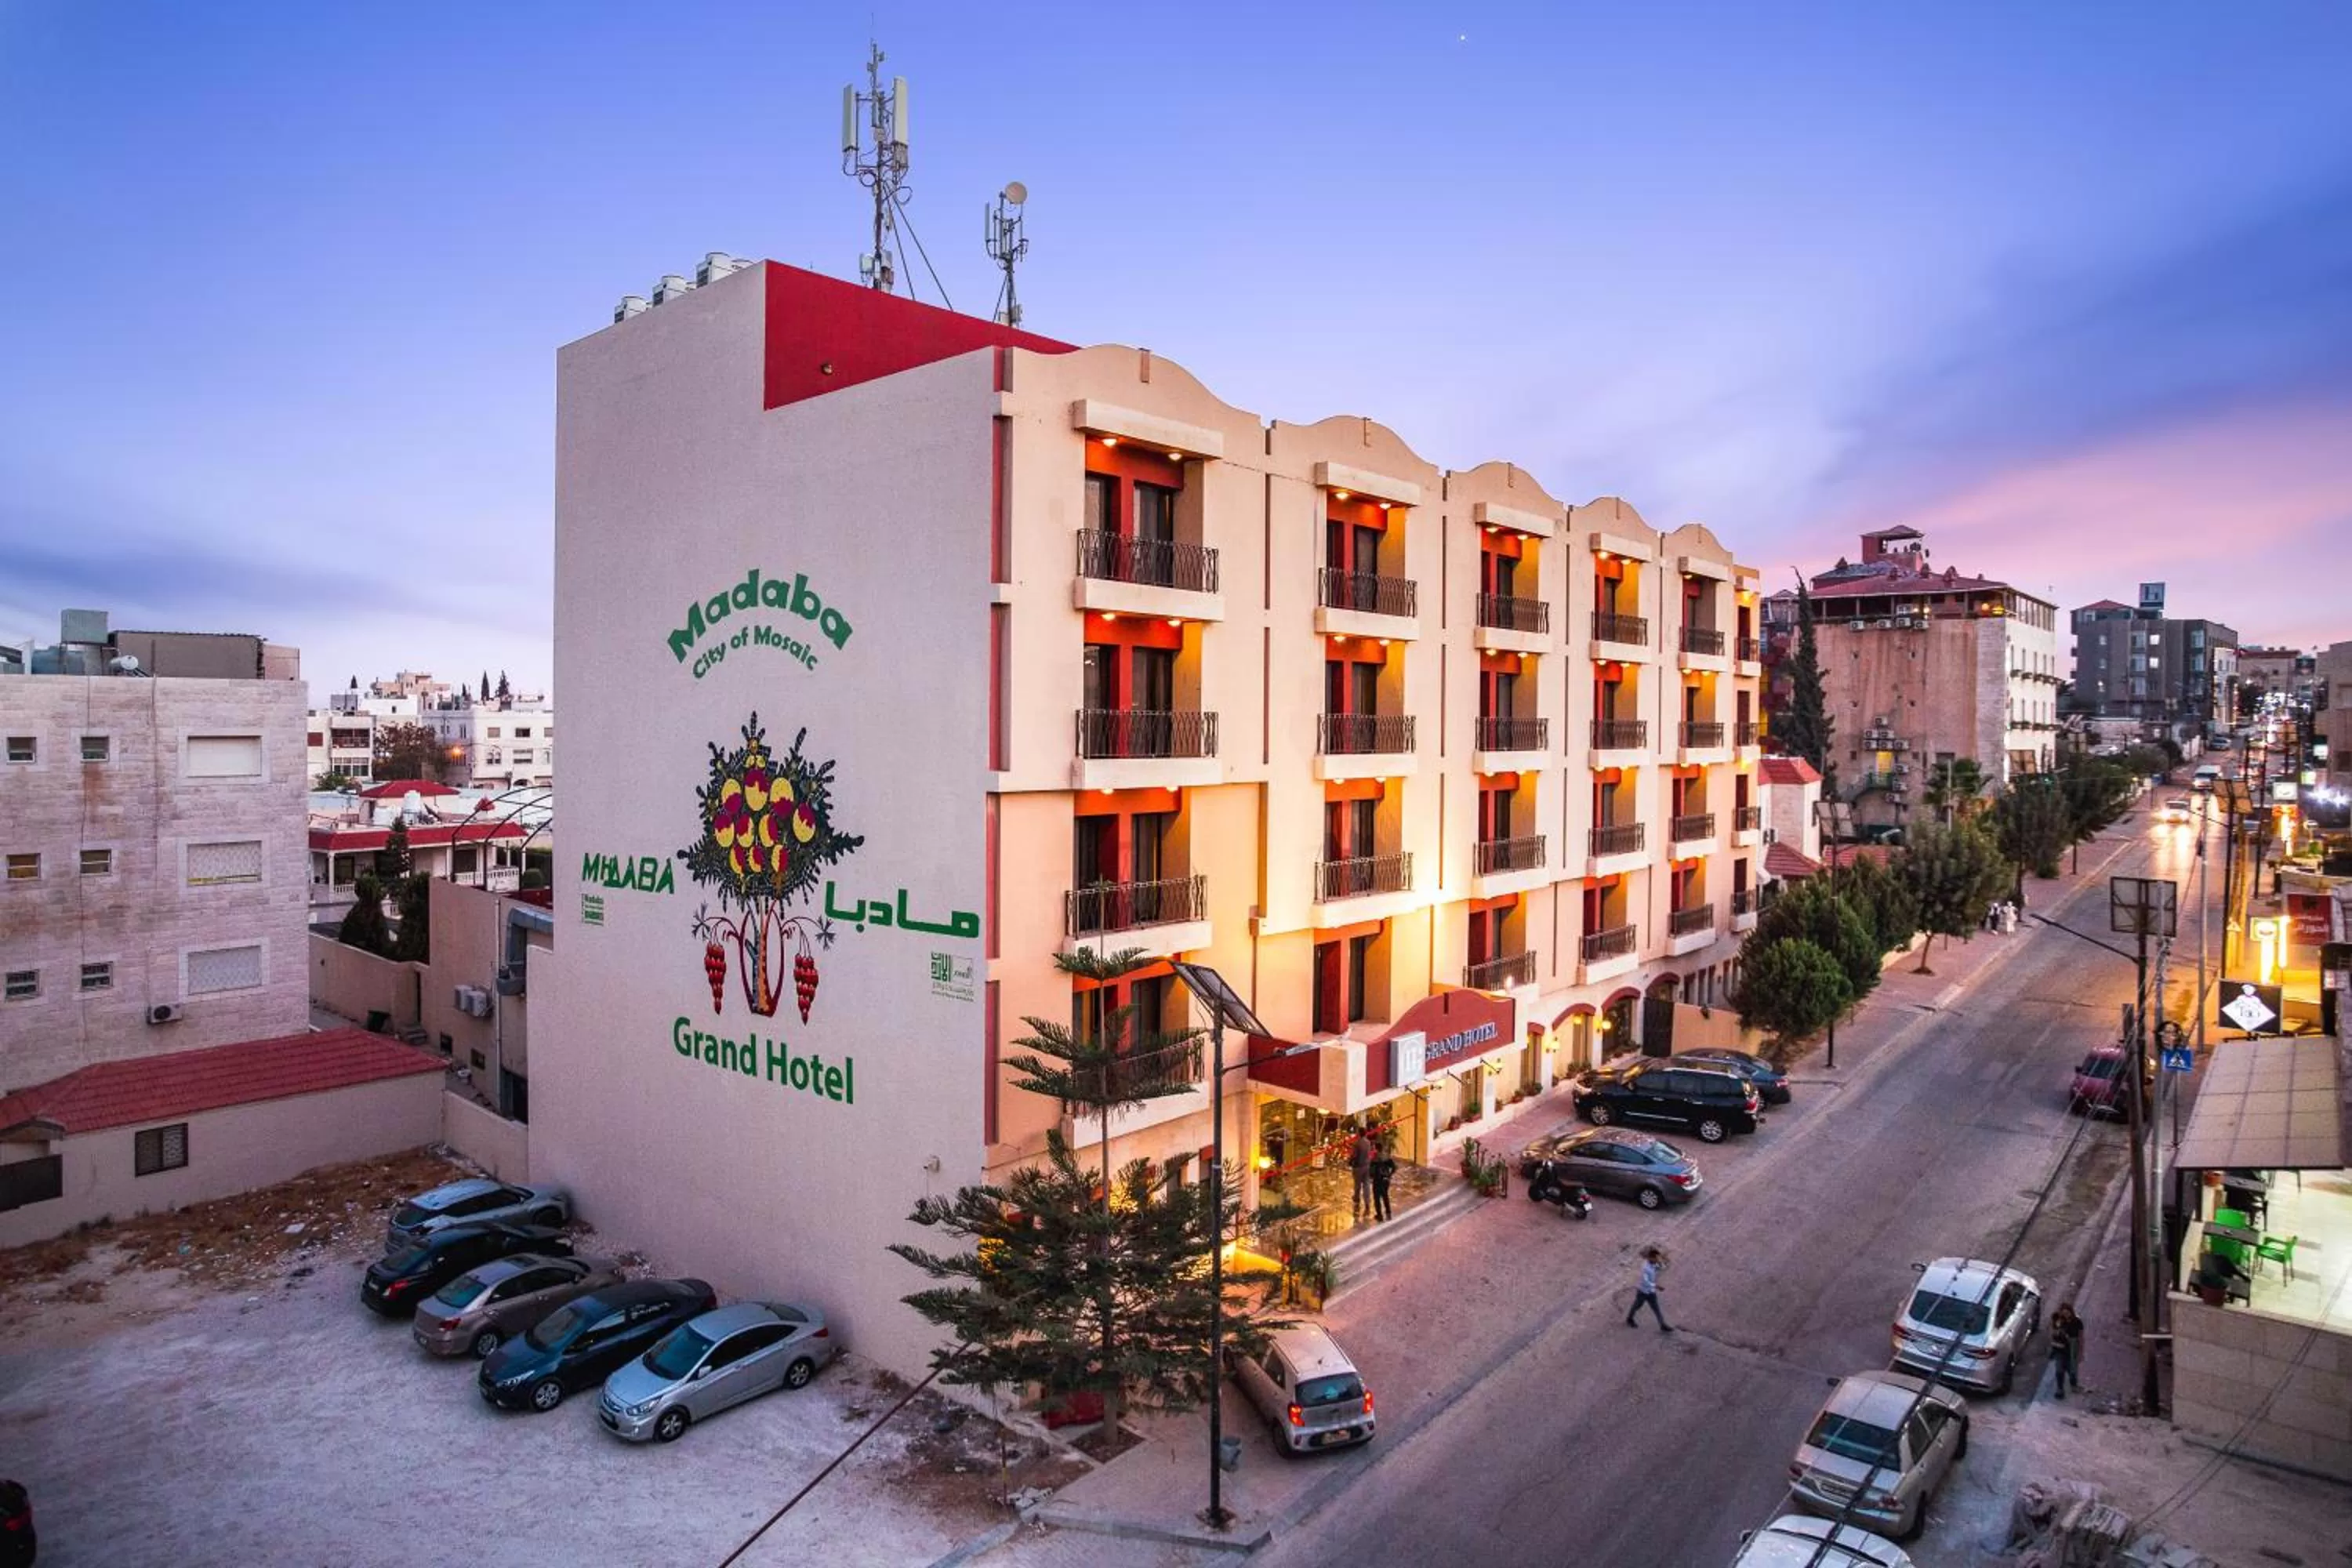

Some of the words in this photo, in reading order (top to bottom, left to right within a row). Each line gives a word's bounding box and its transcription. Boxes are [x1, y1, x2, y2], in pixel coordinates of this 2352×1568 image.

[667, 568, 854, 662] Madaba
[692, 642, 727, 679] City
[730, 626, 750, 650] of
[753, 625, 818, 672] Mosaic
[673, 1015, 758, 1077] Grand
[766, 1039, 854, 1105] Hotel
[1464, 1022, 1497, 1047] HOTEL
